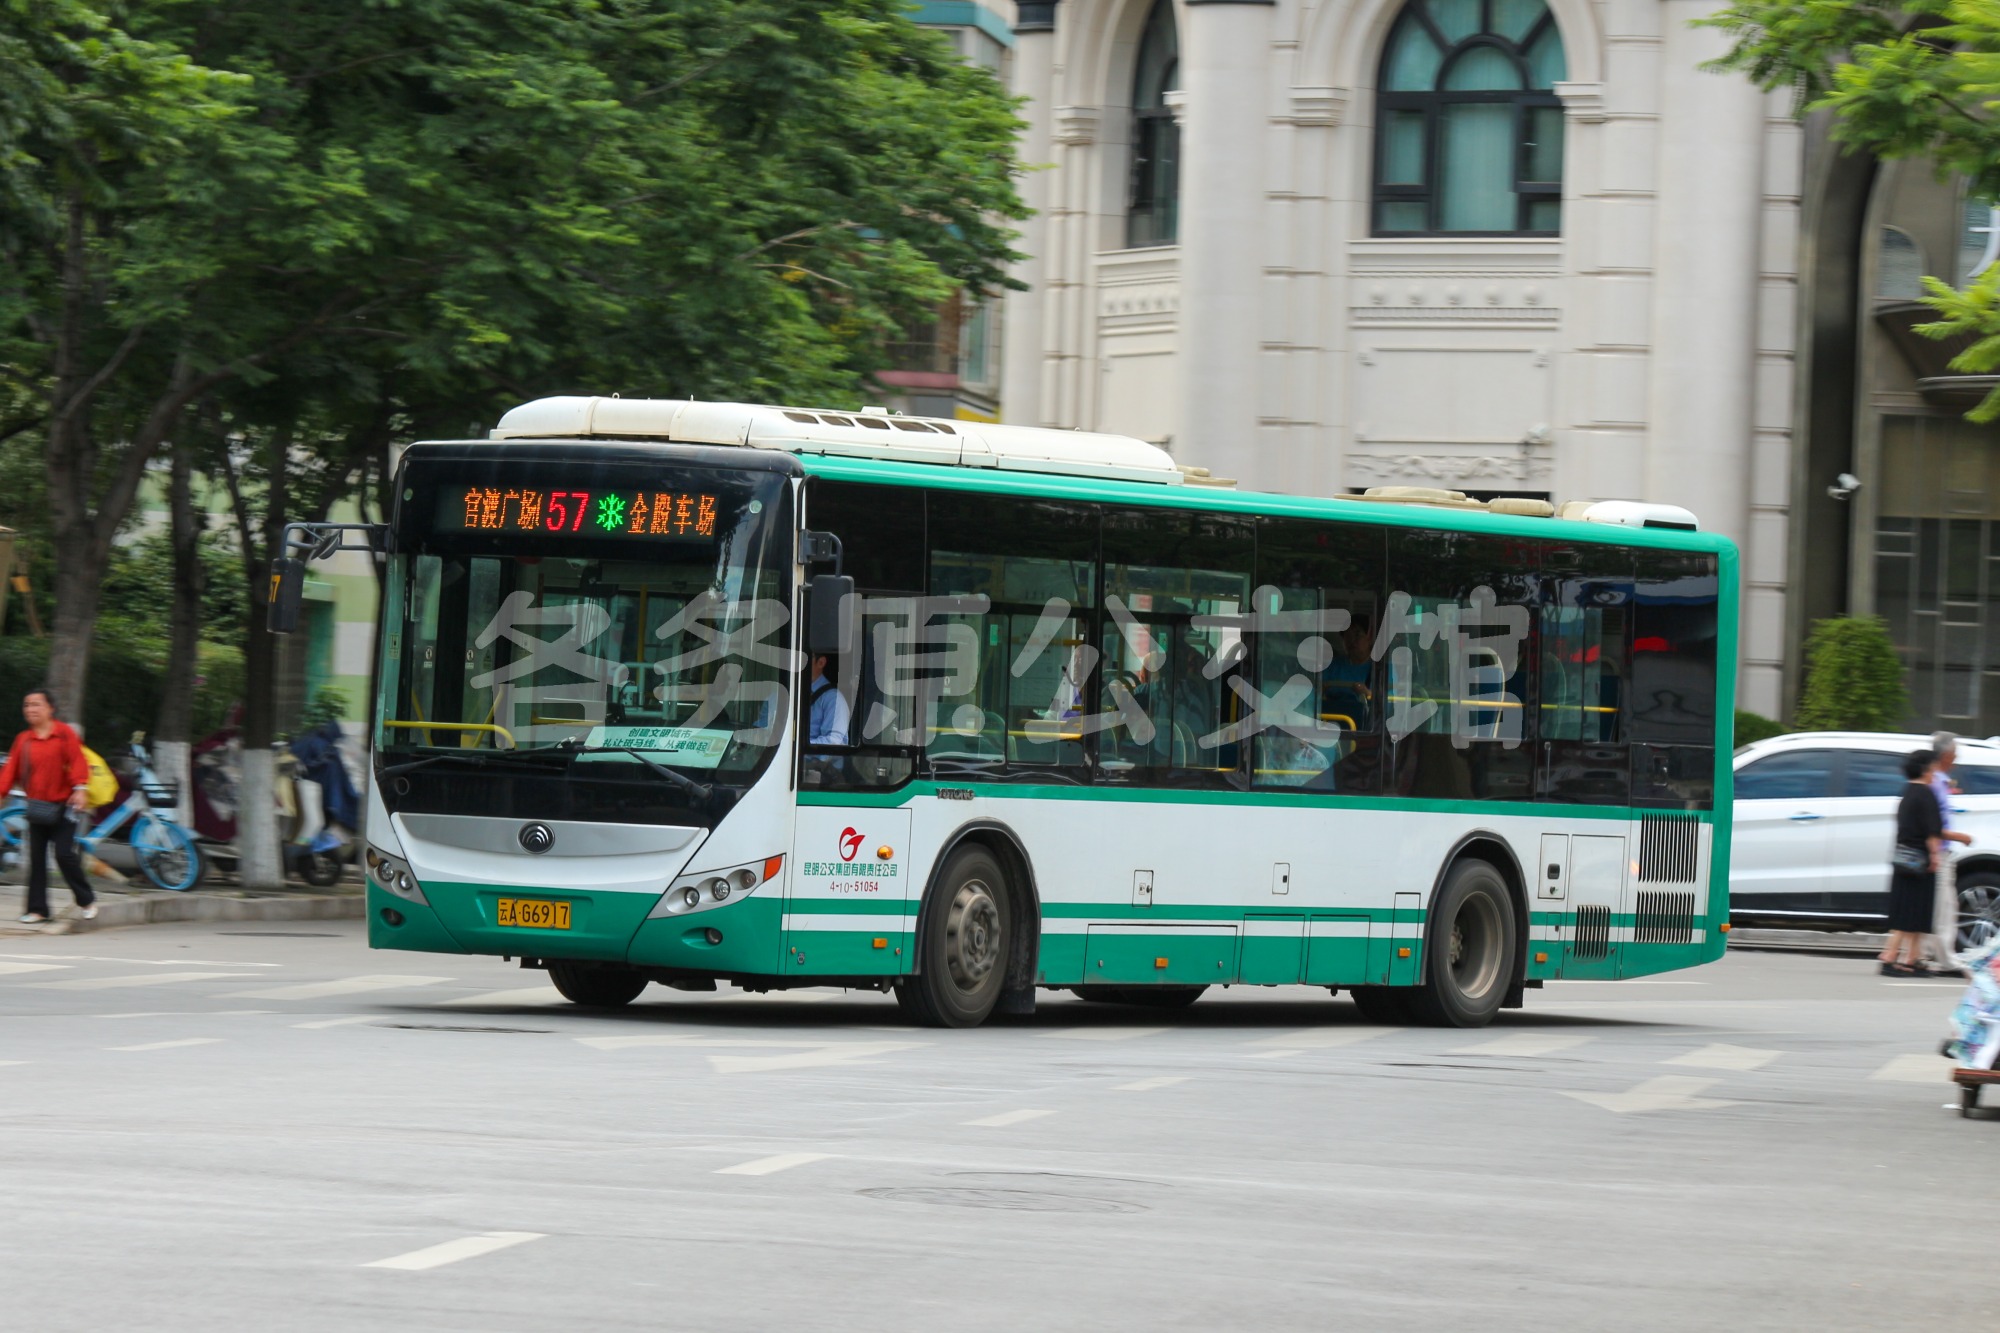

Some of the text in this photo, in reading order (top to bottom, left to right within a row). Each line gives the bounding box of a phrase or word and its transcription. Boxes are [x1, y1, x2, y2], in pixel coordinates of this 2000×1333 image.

[546, 491, 590, 532] 57
[628, 728, 693, 739] 创建文明城市
[804, 862, 898, 877] 昆明公交集团有限责任公司
